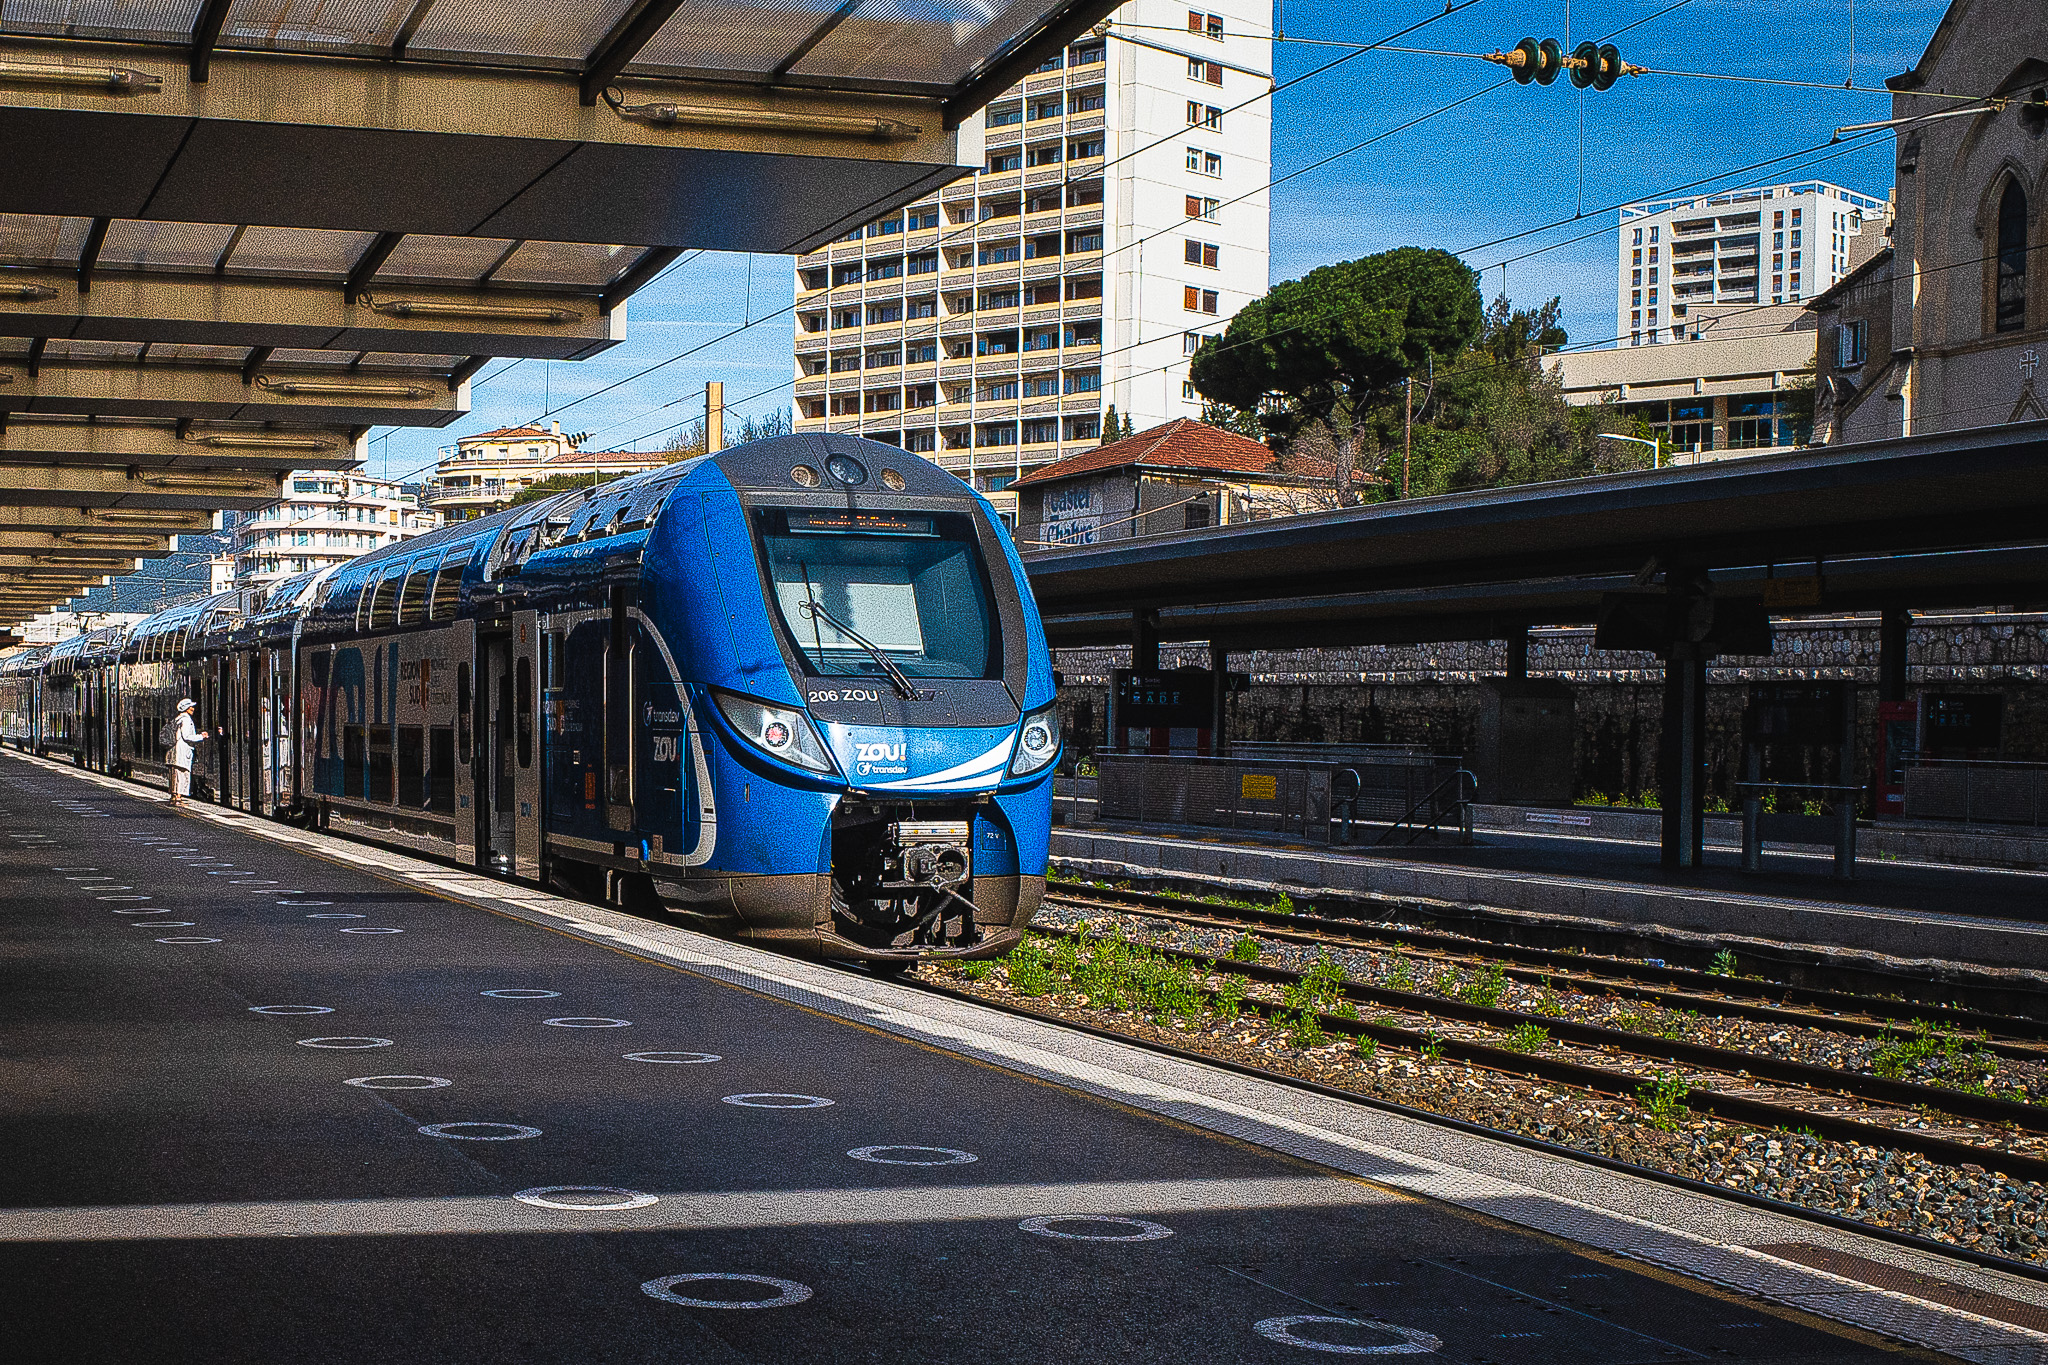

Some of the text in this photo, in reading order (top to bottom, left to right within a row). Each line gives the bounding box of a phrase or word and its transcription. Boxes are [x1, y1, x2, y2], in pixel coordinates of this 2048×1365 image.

[808, 689, 879, 703] 206 ZOU
[855, 743, 908, 762] ZOU!
[872, 764, 908, 775] transdev
